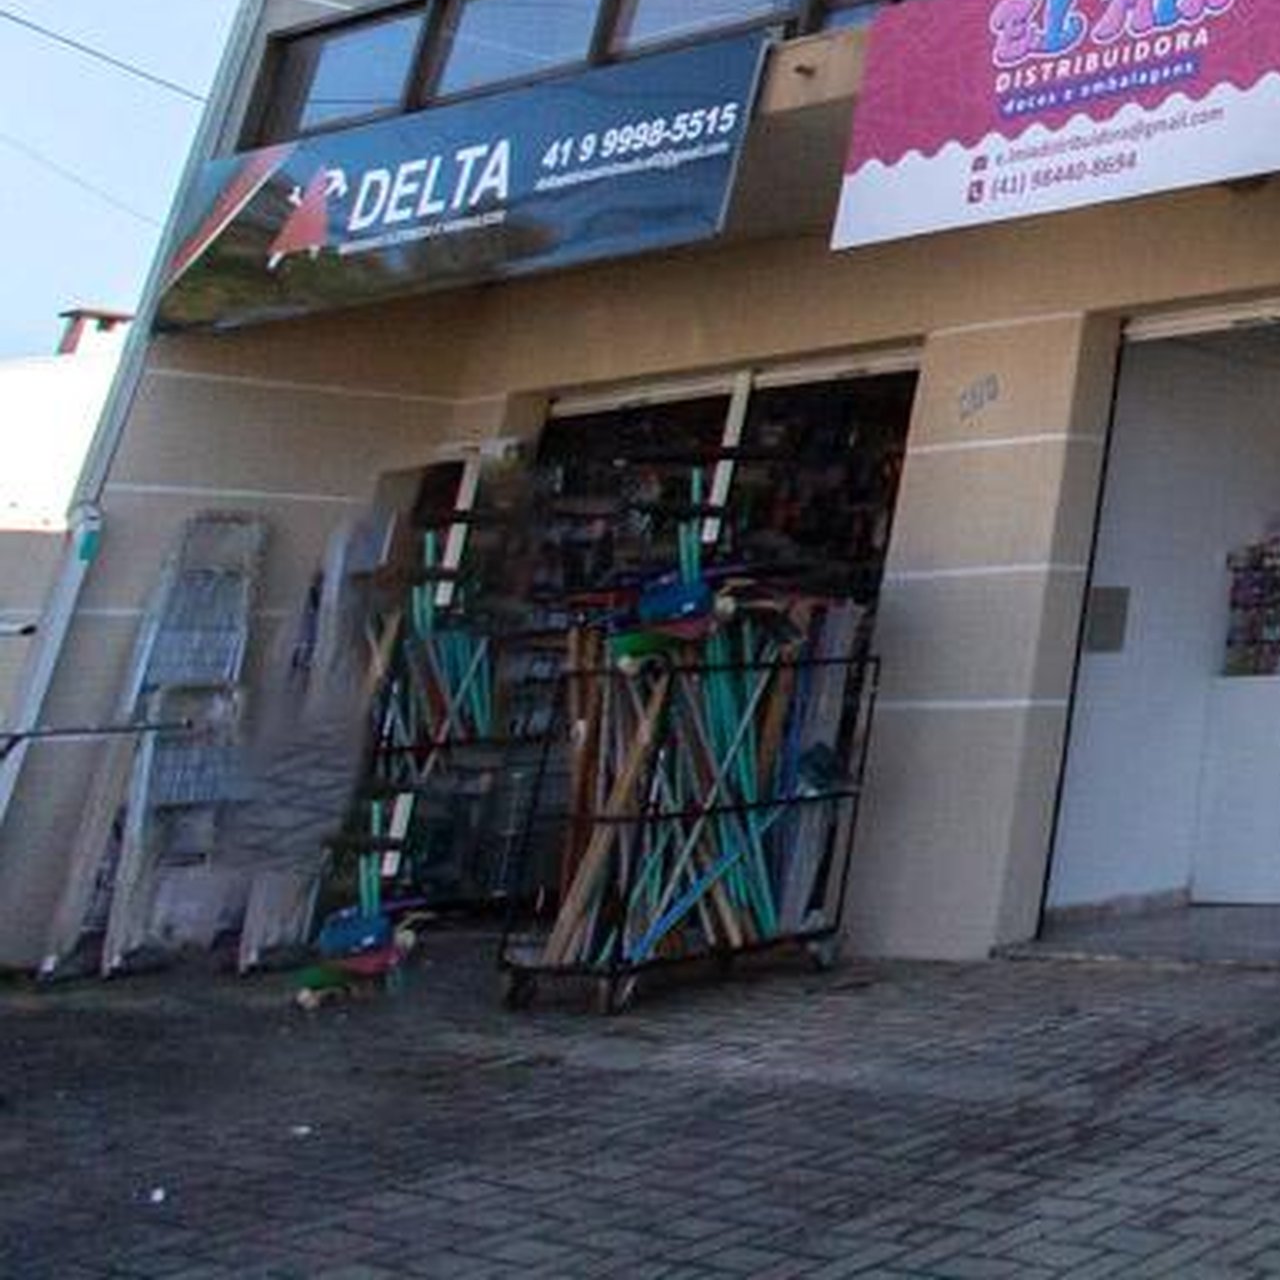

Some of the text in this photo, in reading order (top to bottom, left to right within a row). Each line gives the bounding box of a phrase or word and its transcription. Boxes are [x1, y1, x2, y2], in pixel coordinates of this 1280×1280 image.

[994, 27, 1209, 93] DISTRIBUIDORA
[1003, 87, 1057, 115] doces
[1079, 61, 1195, 99] embalagens
[542, 138, 574, 170] 41
[579, 133, 598, 163] 9
[601, 102, 740, 158] 9998-5515
[347, 138, 510, 232] DELTA
[990, 174, 1027, 201] (41)
